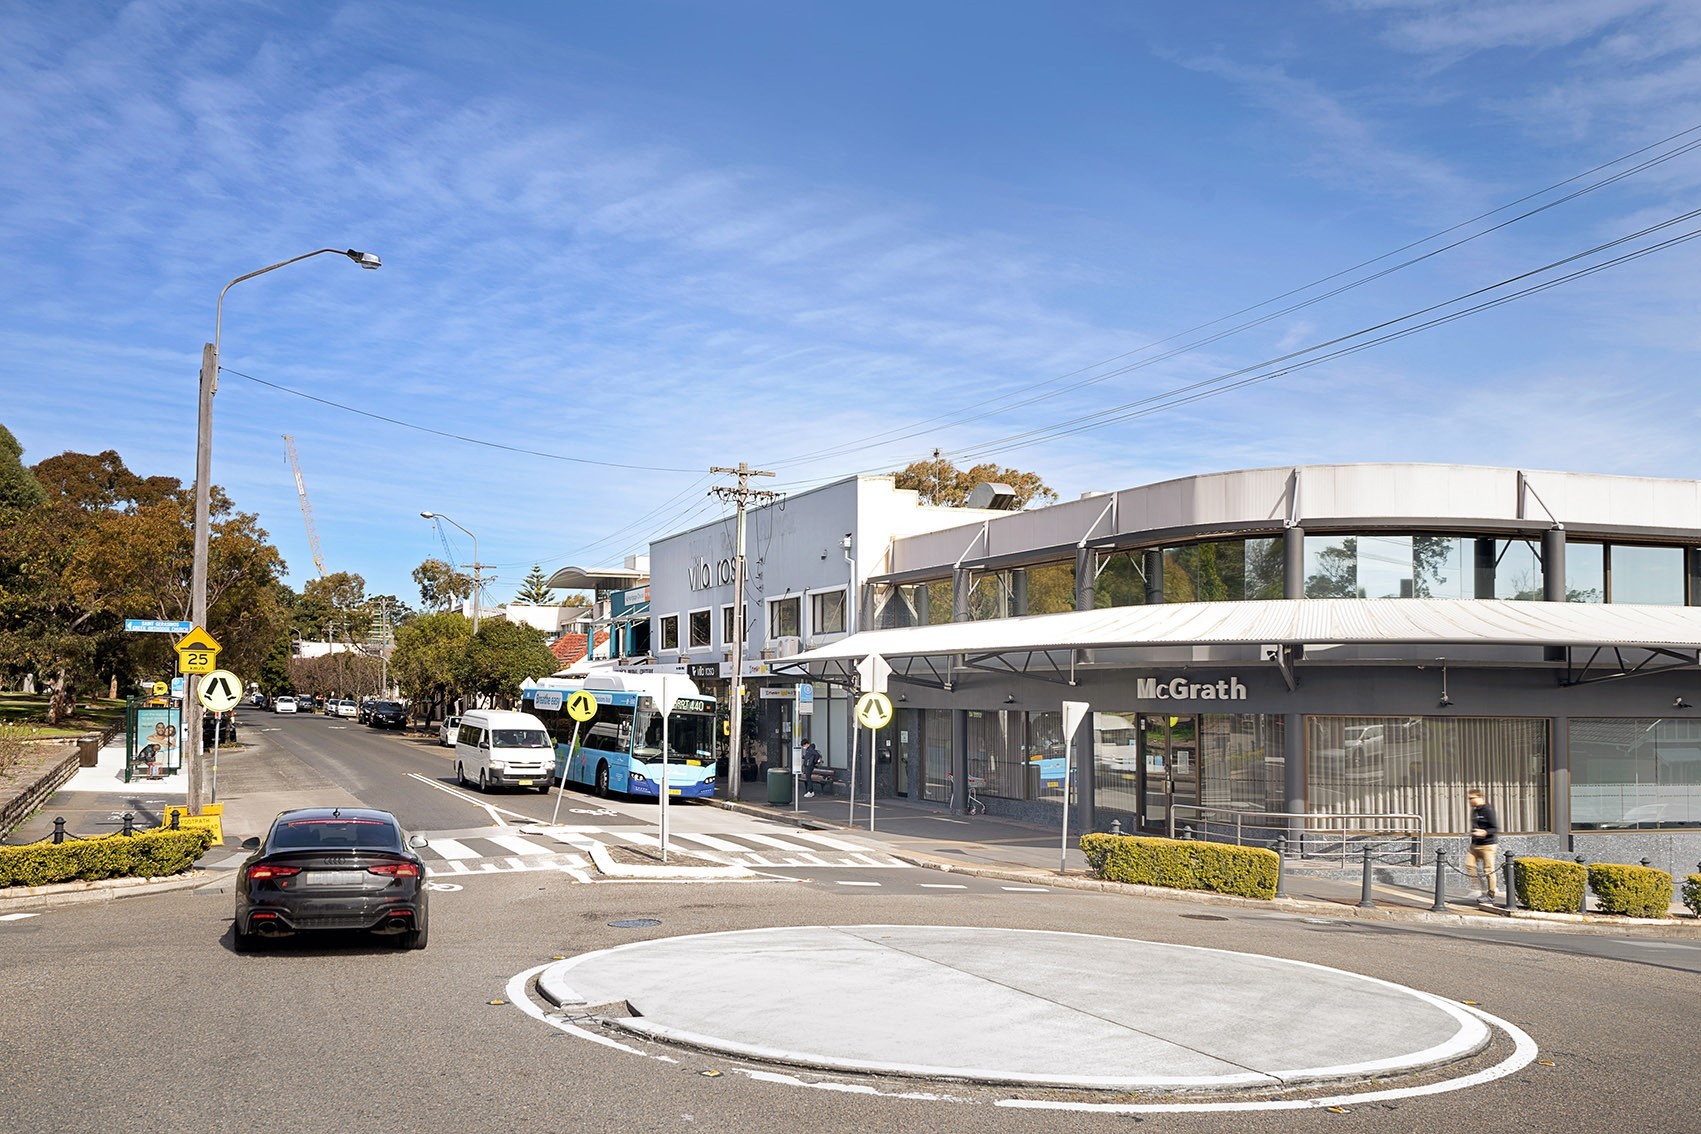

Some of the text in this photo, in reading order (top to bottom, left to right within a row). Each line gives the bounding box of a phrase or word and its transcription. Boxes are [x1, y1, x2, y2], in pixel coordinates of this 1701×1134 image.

[687, 556, 712, 592] villa
[188, 653, 208, 665] 25
[1137, 676, 1247, 700] McGrath
[689, 700, 704, 712] 440
